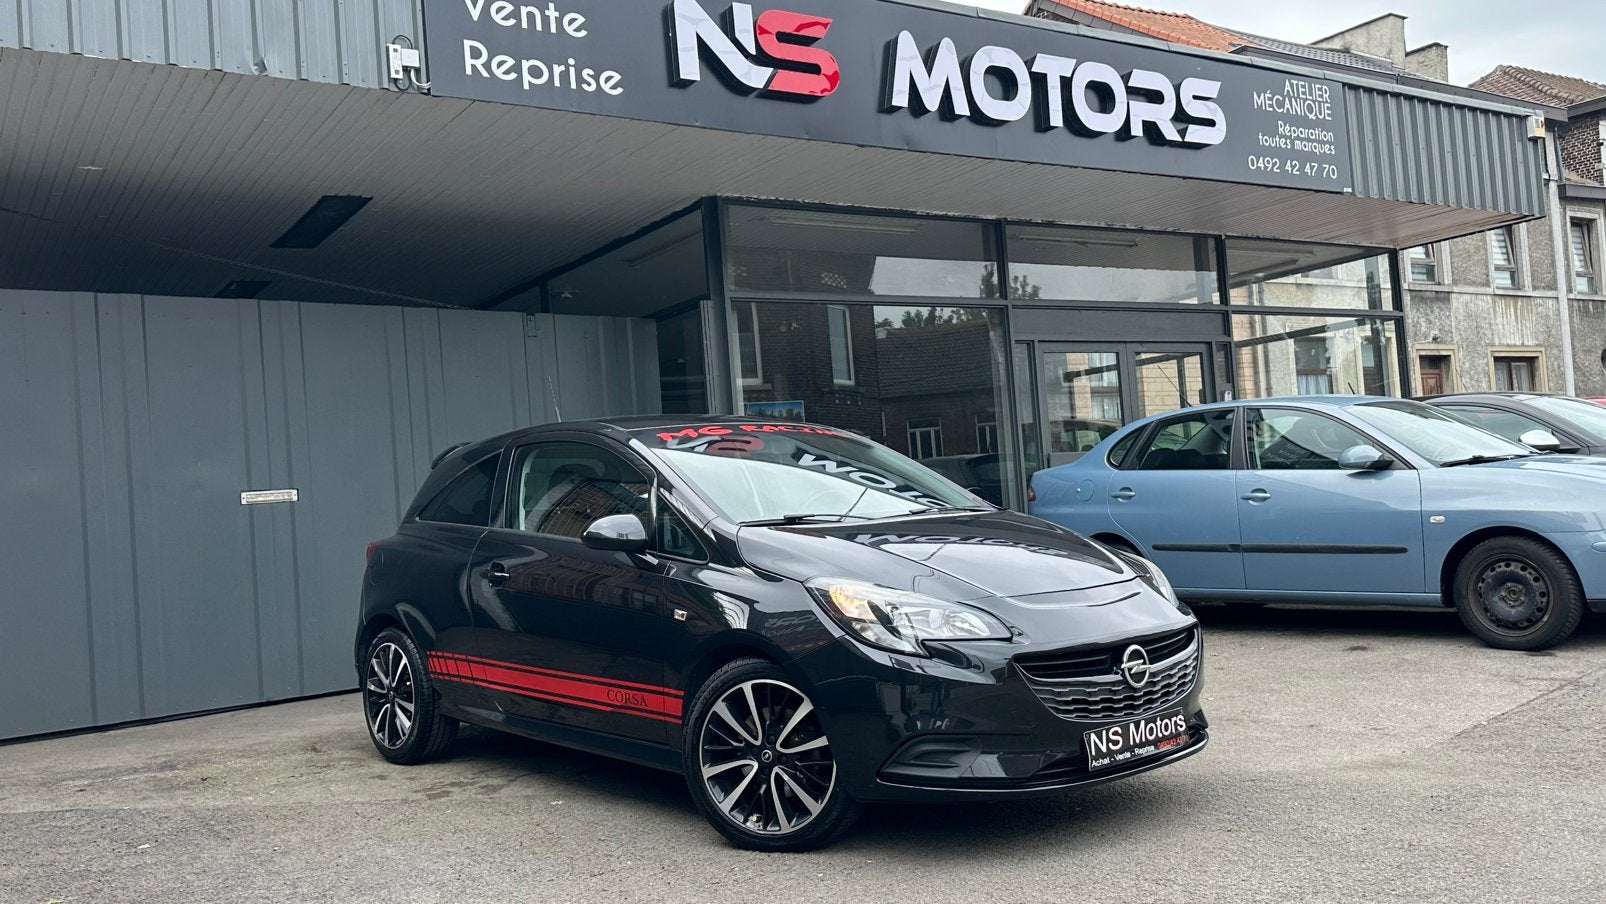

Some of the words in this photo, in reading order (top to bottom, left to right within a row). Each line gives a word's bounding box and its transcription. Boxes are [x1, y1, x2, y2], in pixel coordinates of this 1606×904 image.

[464, 0, 588, 38] Vente
[463, 39, 624, 96] Reprise
[672, 0, 841, 97] NS
[890, 30, 1227, 145] MOTORS
[1284, 79, 1331, 103] ATELIER
[1253, 90, 1332, 120] MÉCANIQUE
[1278, 120, 1334, 142] Réparation
[1258, 132, 1291, 149] toutes
[1294, 140, 1336, 155] marques
[1248, 155, 1281, 173] 0492
[1284, 160, 1300, 175] 42
[1304, 162, 1318, 176] 47
[1322, 164, 1338, 179] 70
[607, 689, 649, 708] CORSA
[1090, 727, 1123, 756] NS
[1129, 715, 1187, 746] Motors
[1092, 757, 1111, 768] Achat
[1114, 751, 1132, 761] Vente
[1134, 745, 1155, 756] Reprise
